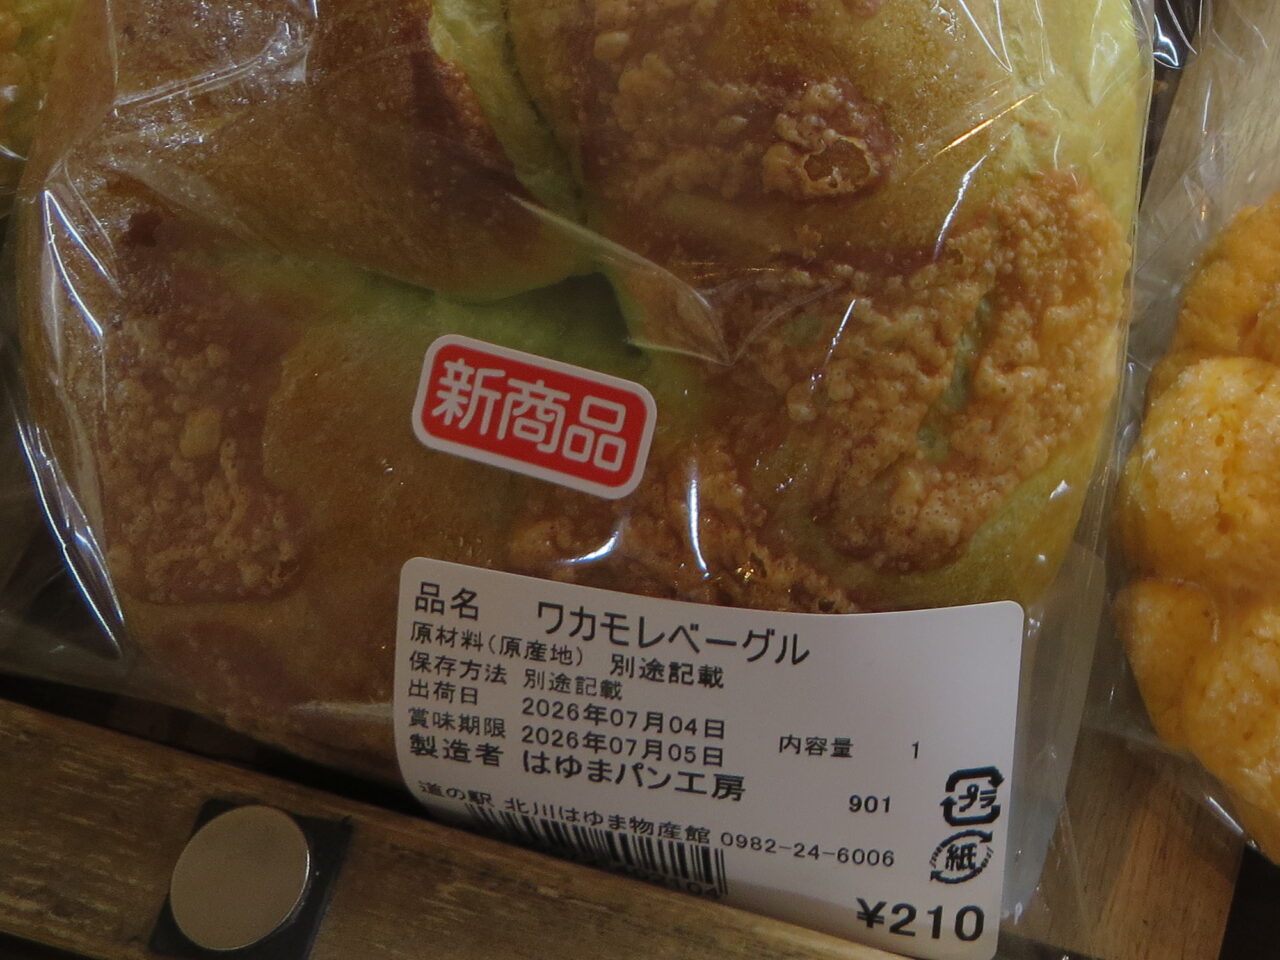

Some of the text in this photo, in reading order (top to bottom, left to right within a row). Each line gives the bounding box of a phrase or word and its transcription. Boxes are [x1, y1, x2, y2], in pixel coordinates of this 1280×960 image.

[432, 358, 626, 472] 新商品
[414, 581, 810, 666] 品名 ワカモレベーグル
[408, 650, 623, 701] 保存方法 別途記載
[410, 621, 725, 689] 原材料(原産地) 別途記載
[407, 679, 725, 740] 出荷日 2026年07月04日
[407, 707, 724, 768] 賞味期限 2026年07月05日
[409, 734, 746, 802] 製造者 はゆまパン工房
[778, 734, 920, 760] 内容量 1
[417, 780, 495, 808] 道の駅
[504, 797, 711, 845] 北川はゆま物産館
[720, 832, 895, 868] 0982-24-6006
[848, 794, 892, 814] 901
[958, 783, 998, 813] プラ
[856, 897, 985, 942] ¥210
